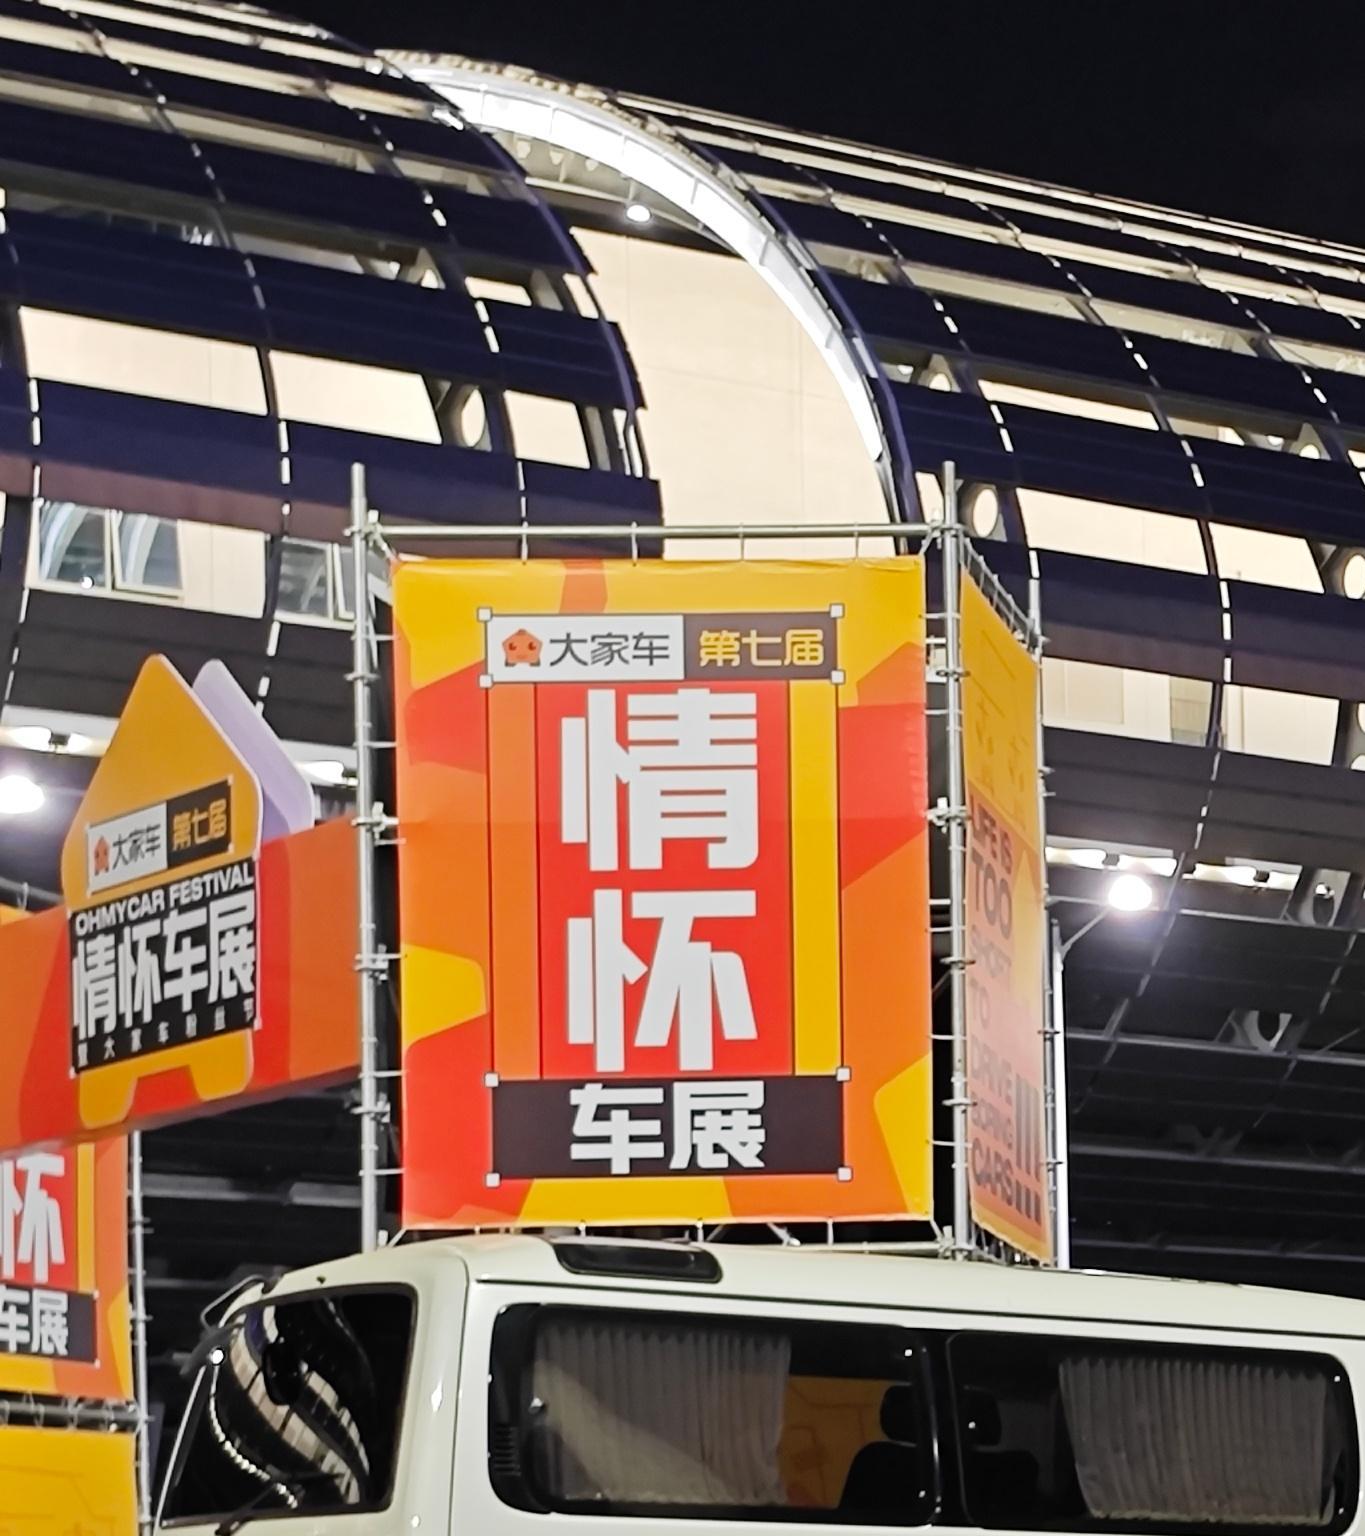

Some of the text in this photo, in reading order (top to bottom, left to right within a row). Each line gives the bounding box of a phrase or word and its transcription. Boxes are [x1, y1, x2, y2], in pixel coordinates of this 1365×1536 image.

[549, 632, 670, 667] 大家车
[699, 628, 824, 667] 第七届
[112, 823, 161, 871] 大家车
[173, 798, 227, 852] 第七届
[75, 862, 254, 937] OHMYCAR FESTIVAL
[561, 688, 759, 1072] 情怀
[970, 846, 1013, 940] TOO
[72, 890, 255, 1041] 情怀车展
[569, 1079, 766, 1176] 车展
[971, 1136, 1013, 1207] CARS
